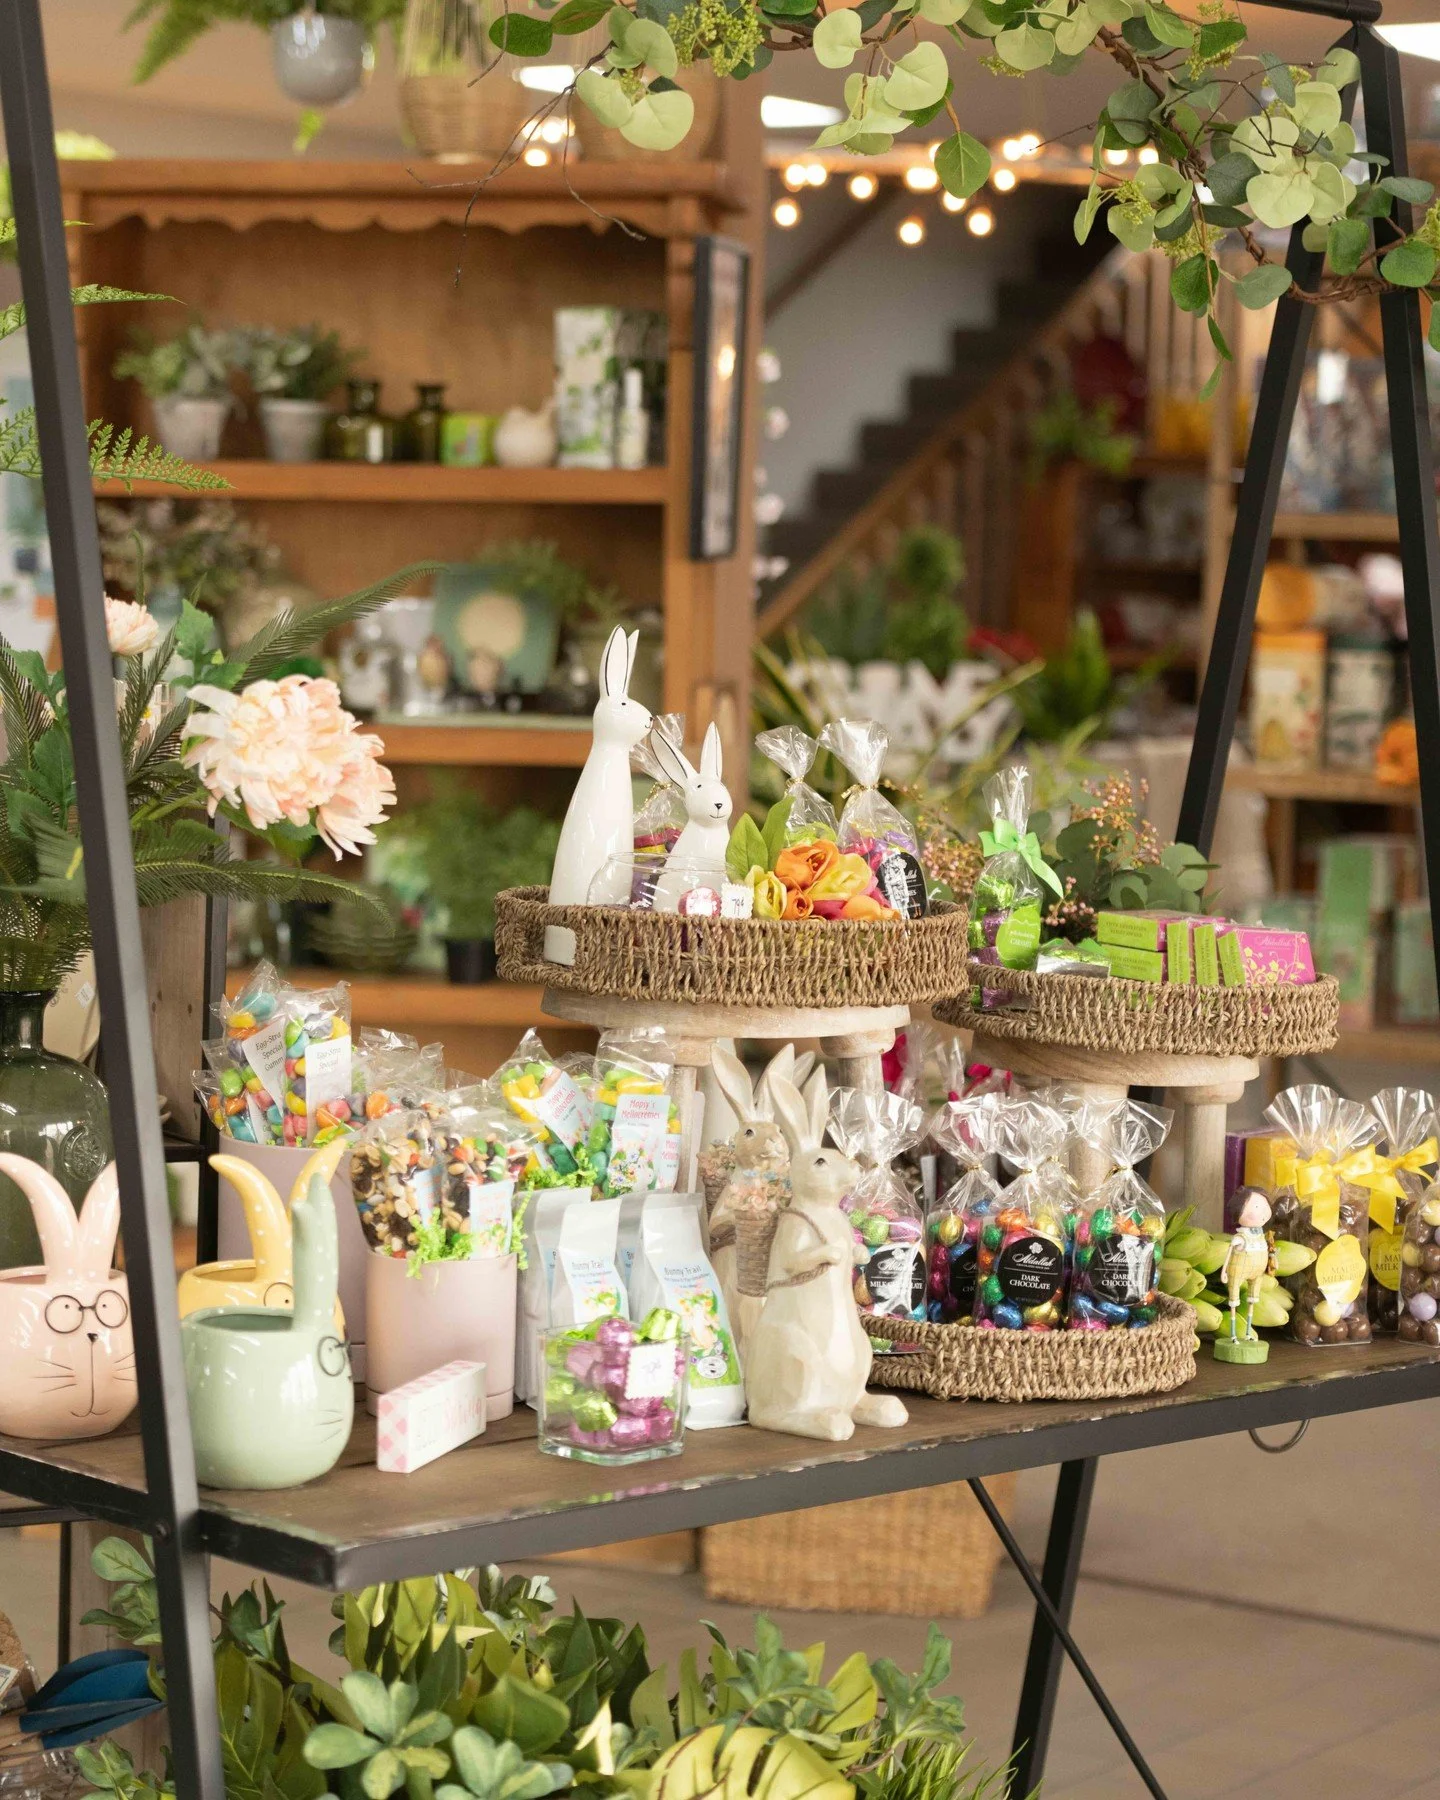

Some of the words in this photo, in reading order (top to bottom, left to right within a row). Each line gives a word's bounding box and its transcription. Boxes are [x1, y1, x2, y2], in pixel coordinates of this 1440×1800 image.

[255, 1032, 282, 1051] Egg-Stra
[262, 1041, 284, 1060] Special
[1012, 1253, 1057, 1267] Abdallah
[664, 1266, 685, 1277] Bunny
[685, 1264, 702, 1275] Trail
[1376, 1263, 1399, 1271] MILK
[1009, 1279, 1051, 1290] CHOCOLATE
[1021, 1274, 1041, 1283] DARK
